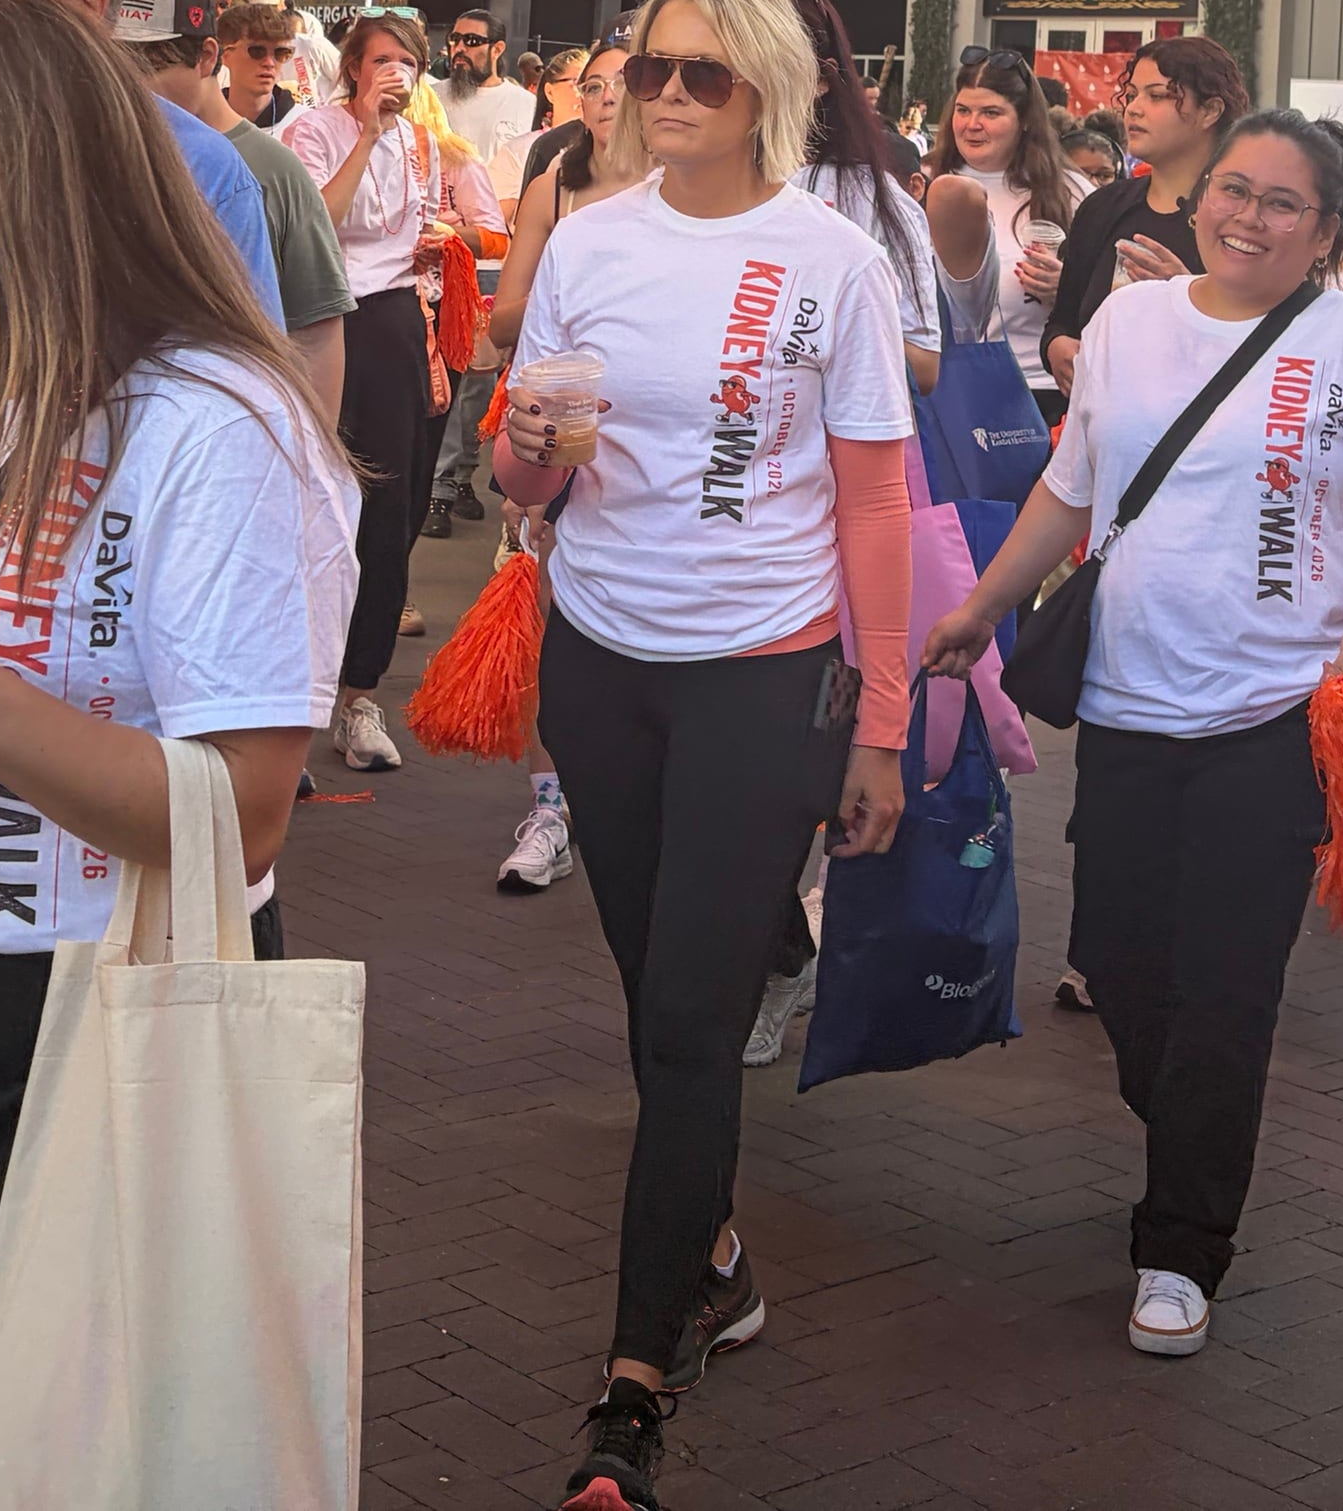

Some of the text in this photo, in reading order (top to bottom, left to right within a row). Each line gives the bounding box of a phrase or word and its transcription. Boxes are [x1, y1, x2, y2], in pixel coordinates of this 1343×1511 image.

[719, 259, 787, 380] KIDNEY
[773, 391, 797, 457] OCTOBER
[1265, 355, 1316, 463] KIDNEY
[700, 429, 756, 524] WALK
[1310, 479, 1330, 541] OCTOBER
[89, 509, 134, 649] DaVita
[1256, 506, 1296, 603] WALK
